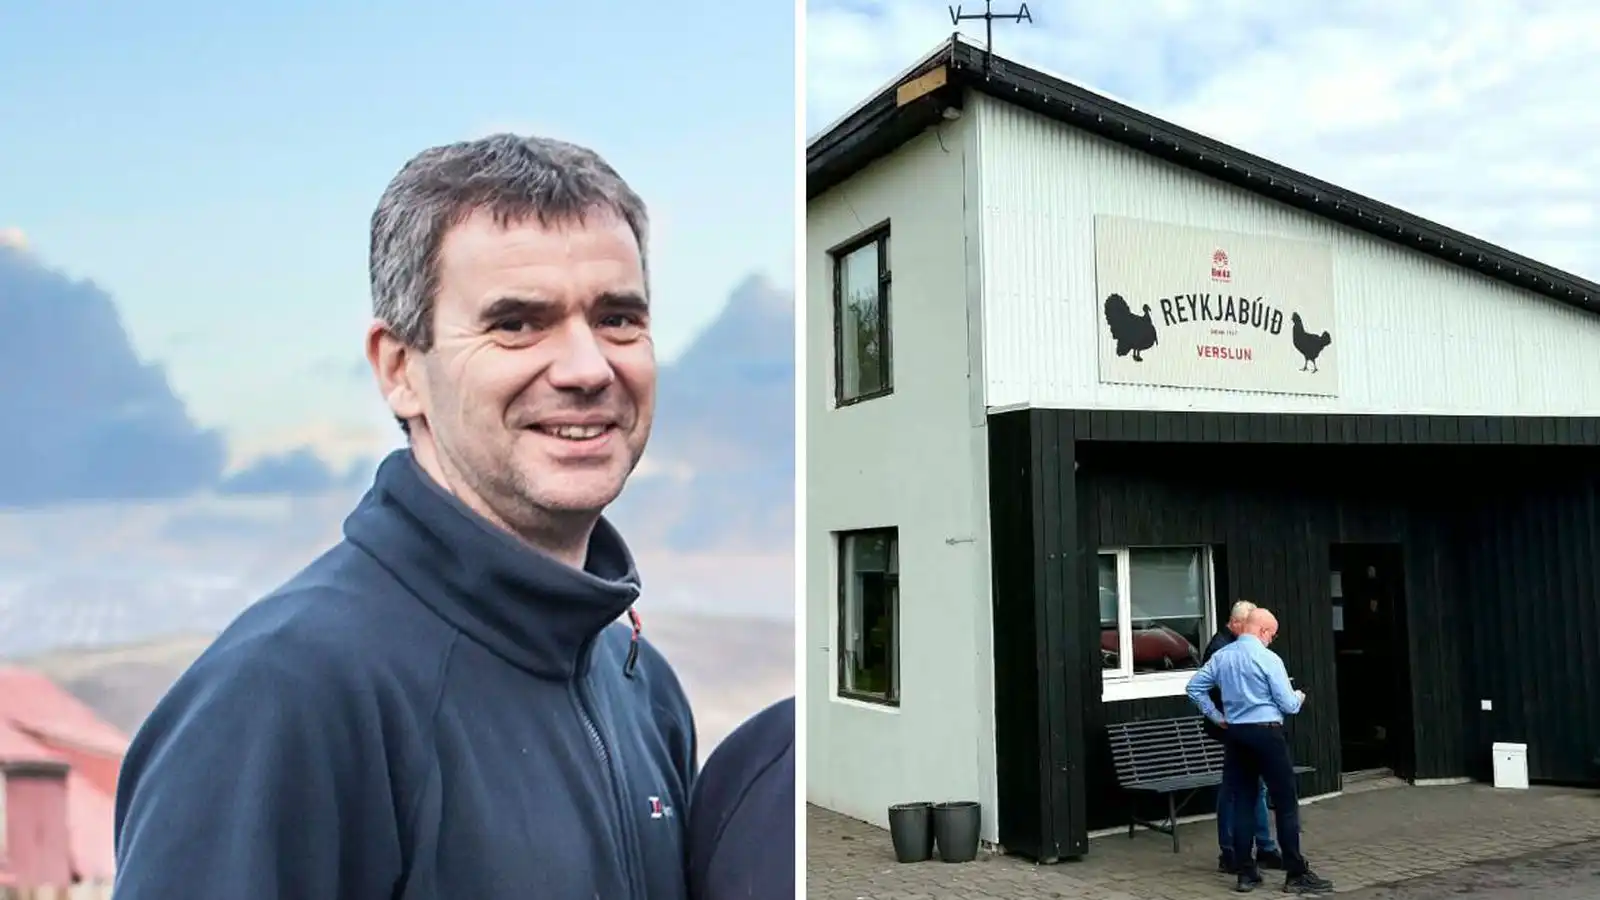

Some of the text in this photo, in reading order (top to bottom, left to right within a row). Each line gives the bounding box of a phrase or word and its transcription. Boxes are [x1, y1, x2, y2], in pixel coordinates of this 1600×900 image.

[948, 3, 1032, 25] V A
[1160, 293, 1283, 335] REYKJABÚIÐ
[1197, 345, 1252, 360] VERSLUN
